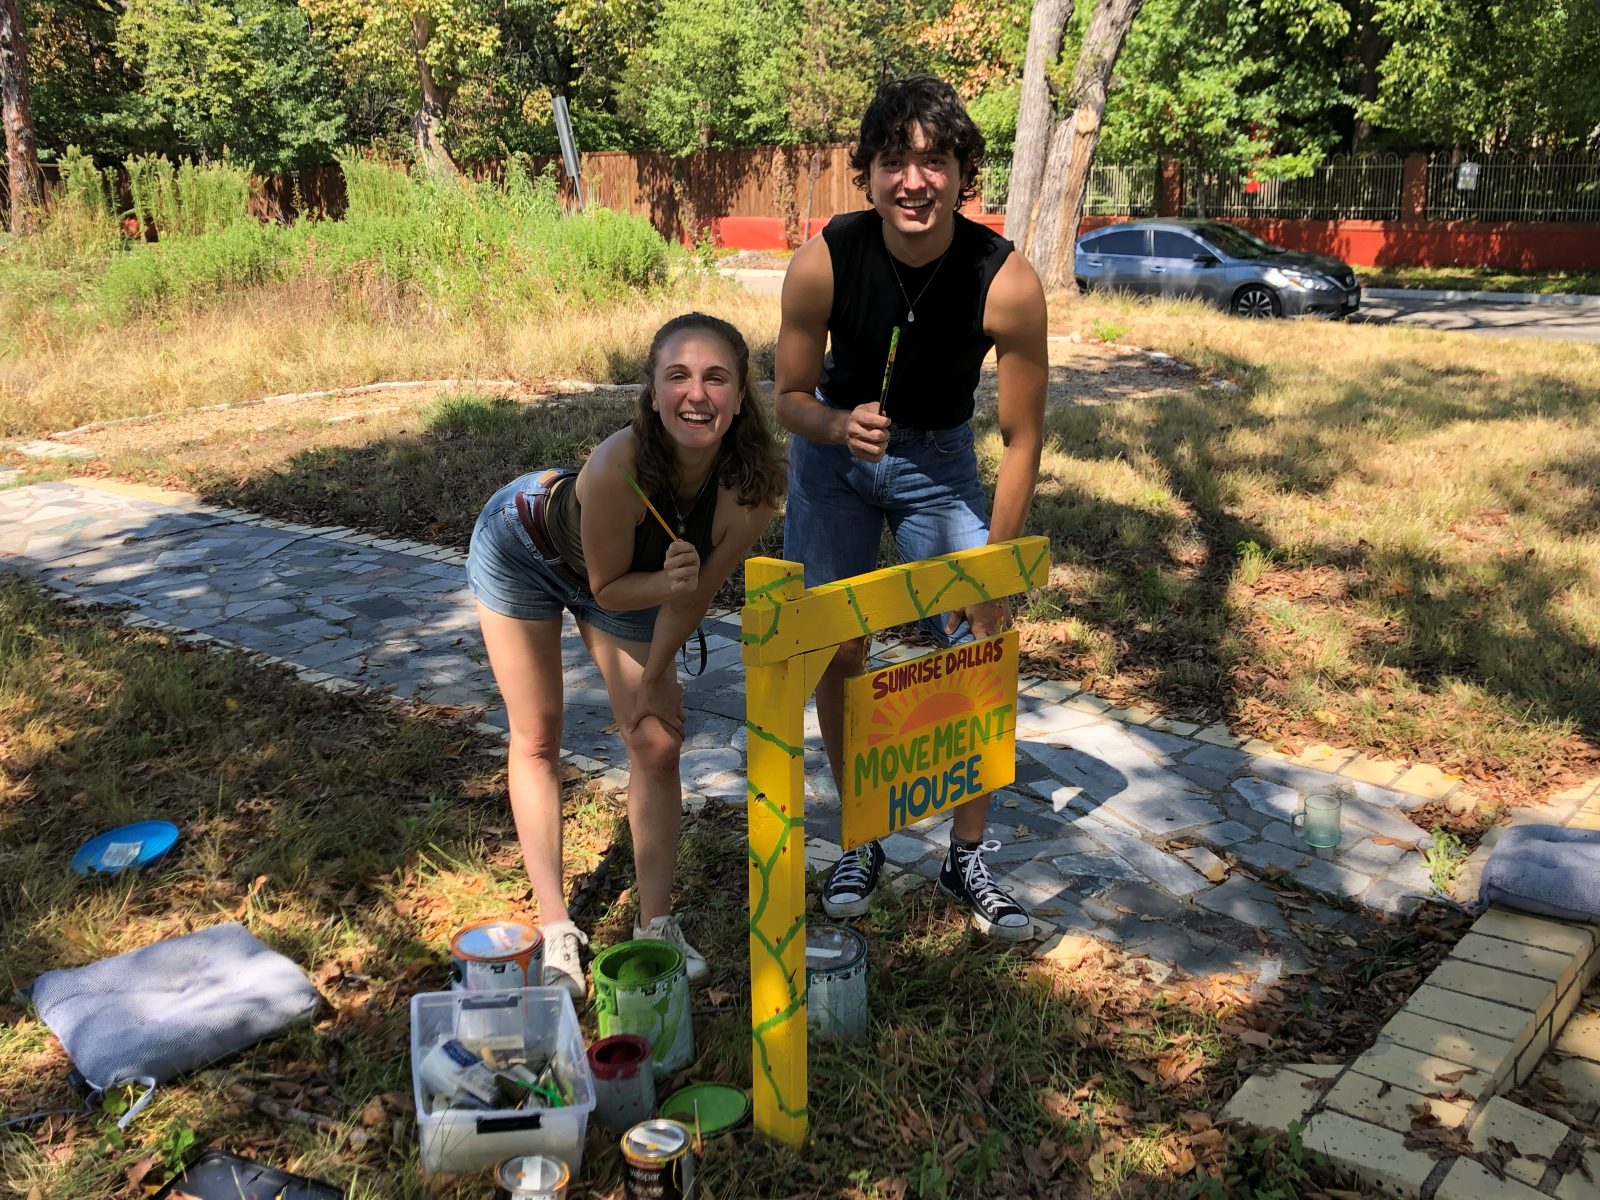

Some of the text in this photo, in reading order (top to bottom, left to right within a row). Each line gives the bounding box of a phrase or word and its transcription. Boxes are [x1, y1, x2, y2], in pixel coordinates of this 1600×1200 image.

[872, 637, 1005, 700] SUNRISE DALLAS
[854, 703, 1013, 797] MOVEMENT
[889, 754, 983, 832] HOUSE
